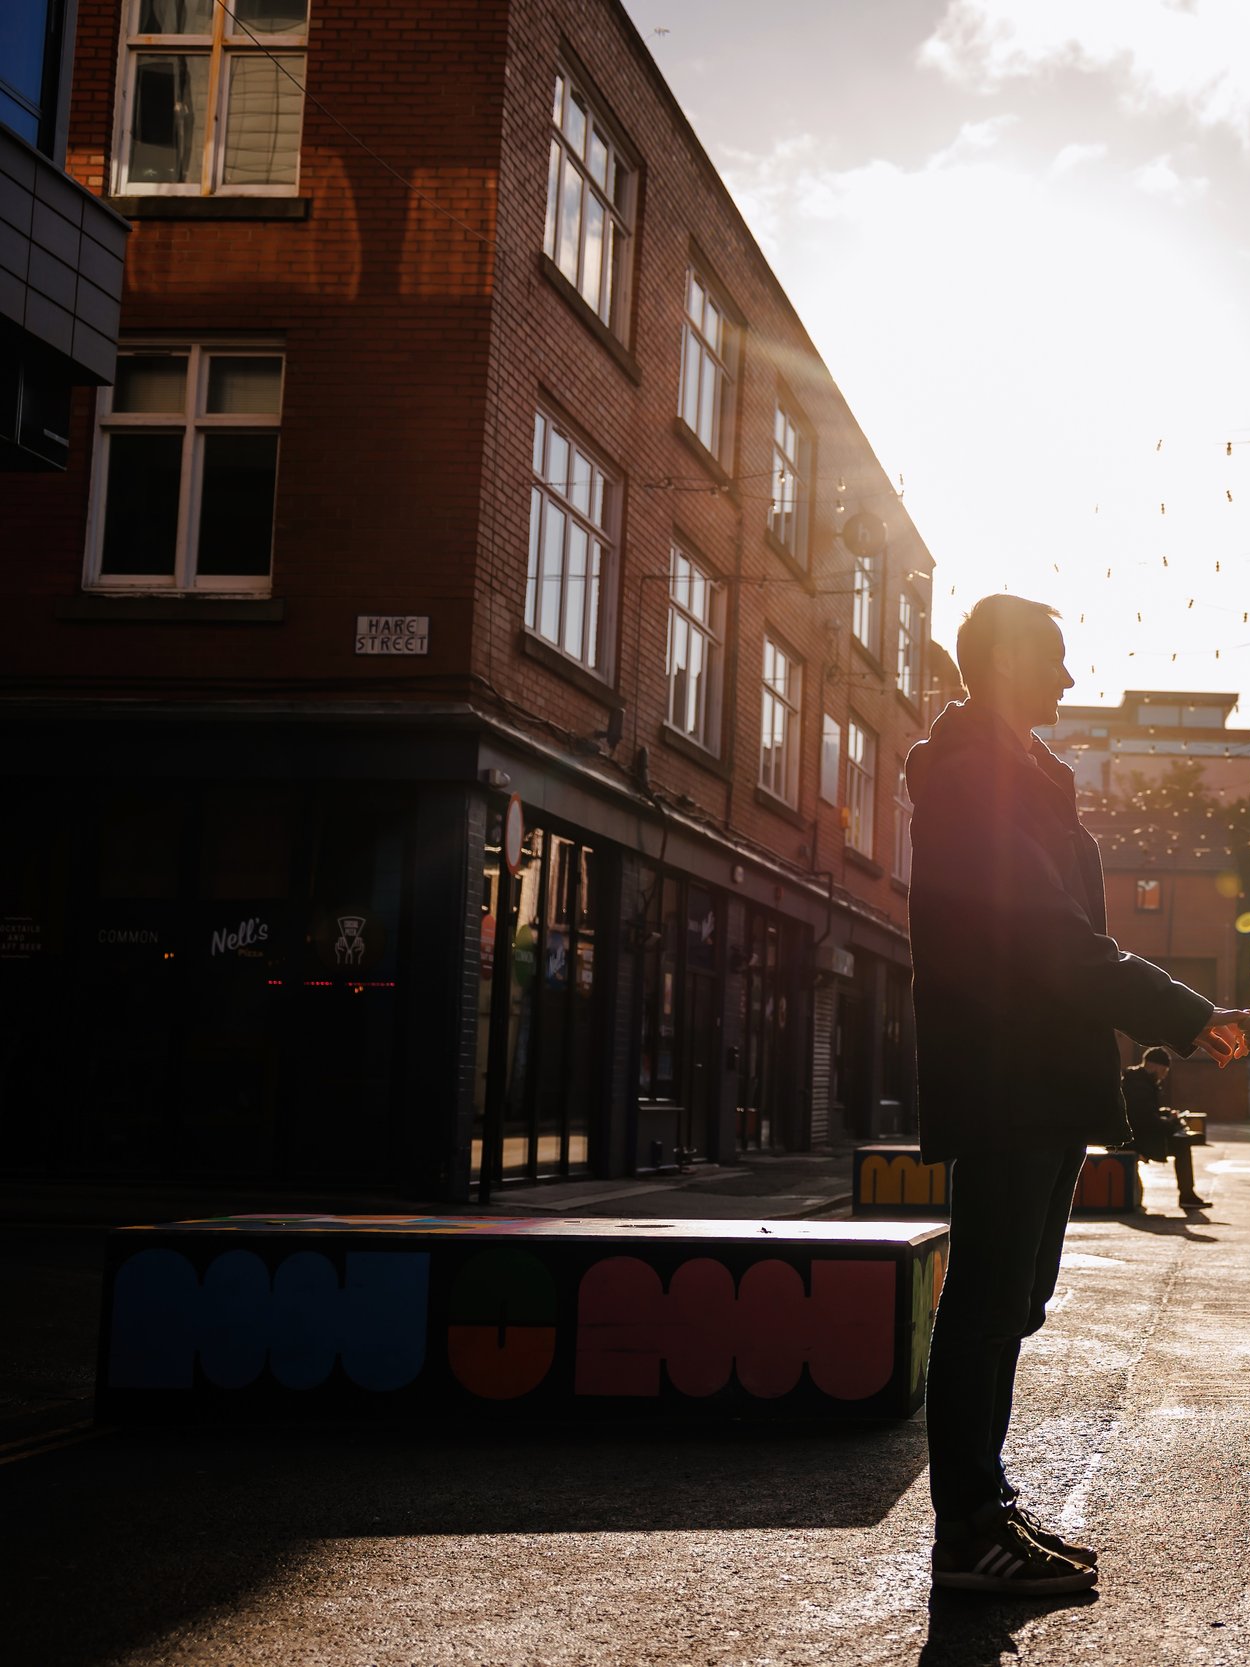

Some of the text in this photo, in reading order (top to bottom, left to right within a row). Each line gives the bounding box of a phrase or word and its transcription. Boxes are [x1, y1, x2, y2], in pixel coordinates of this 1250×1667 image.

[368, 618, 417, 634] HARE
[357, 636, 426, 651] STREET
[97, 928, 159, 944] COMMON
[210, 916, 269, 957] Nell's
[237, 948, 264, 958] Pizza
